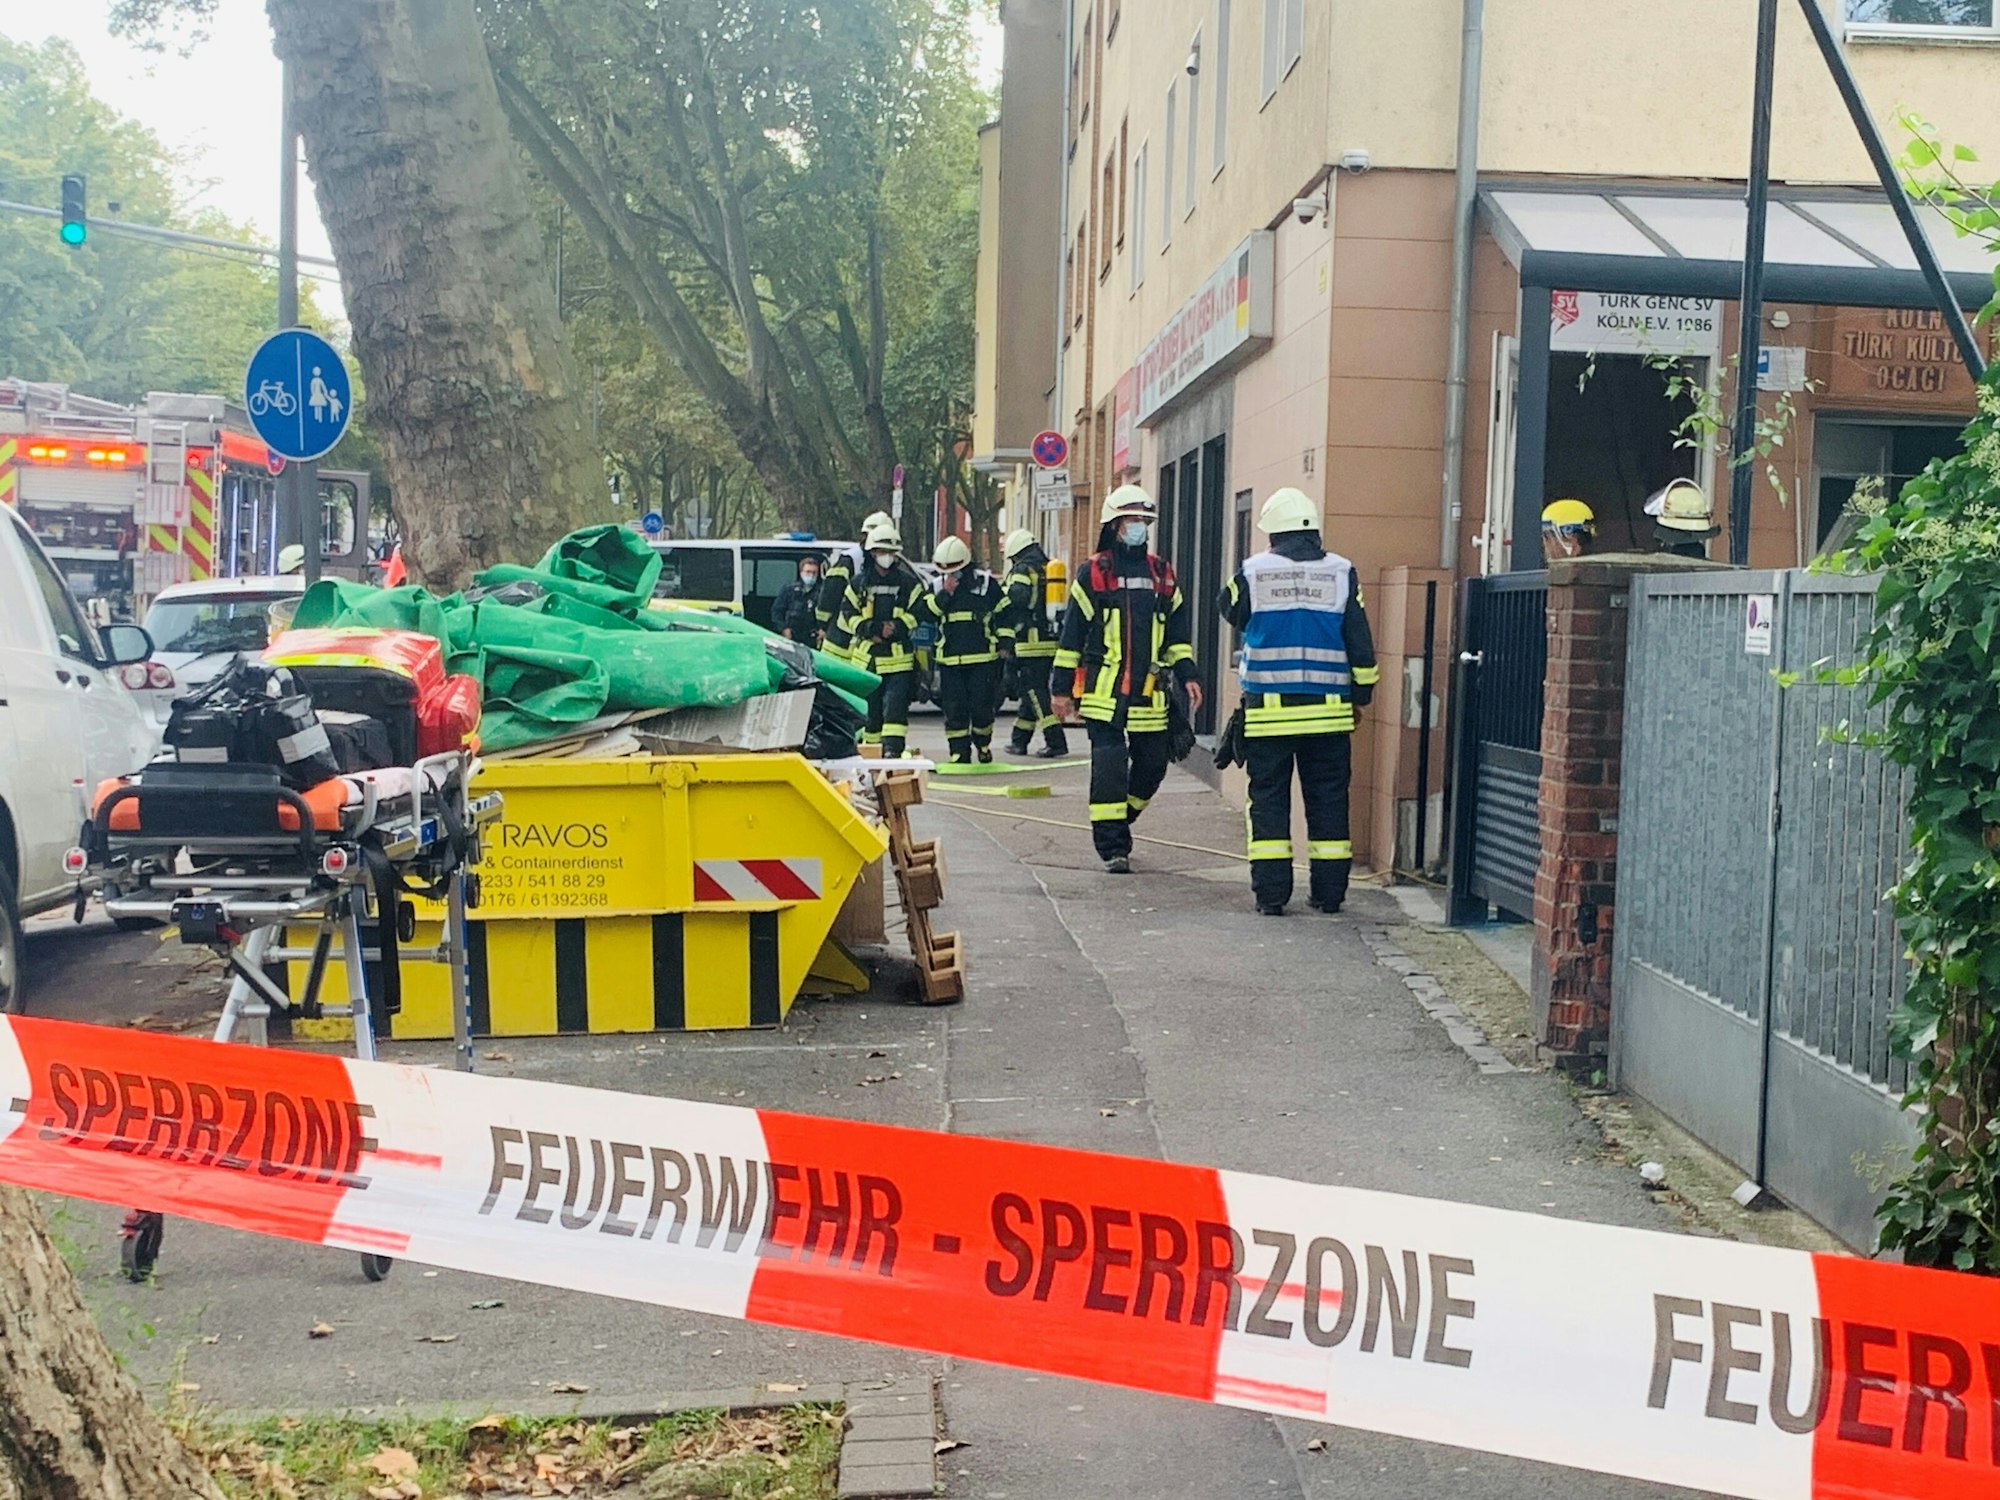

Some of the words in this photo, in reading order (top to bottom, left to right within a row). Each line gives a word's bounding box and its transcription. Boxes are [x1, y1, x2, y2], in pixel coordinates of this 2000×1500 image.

[1557, 295, 1575, 309] SV
[1694, 299, 1714, 311] SV
[1597, 312, 1640, 329] KÖLN
[1645, 316, 1671, 331] E.V.
[1844, 330, 1894, 360] TÜRK
[503, 824, 608, 848] RAVOS
[485, 856, 496, 869] &
[501, 855, 624, 869] Containerdienst
[528, 874, 556, 888] 541
[562, 874, 581, 888] 88
[586, 873, 606, 888] 29
[530, 893, 608, 907] 61392368
[38, 1063, 379, 1190] SPERRZONE
[478, 1125, 904, 1277] FEUERWEHR
[985, 1192, 1476, 1369] SPERRZONE
